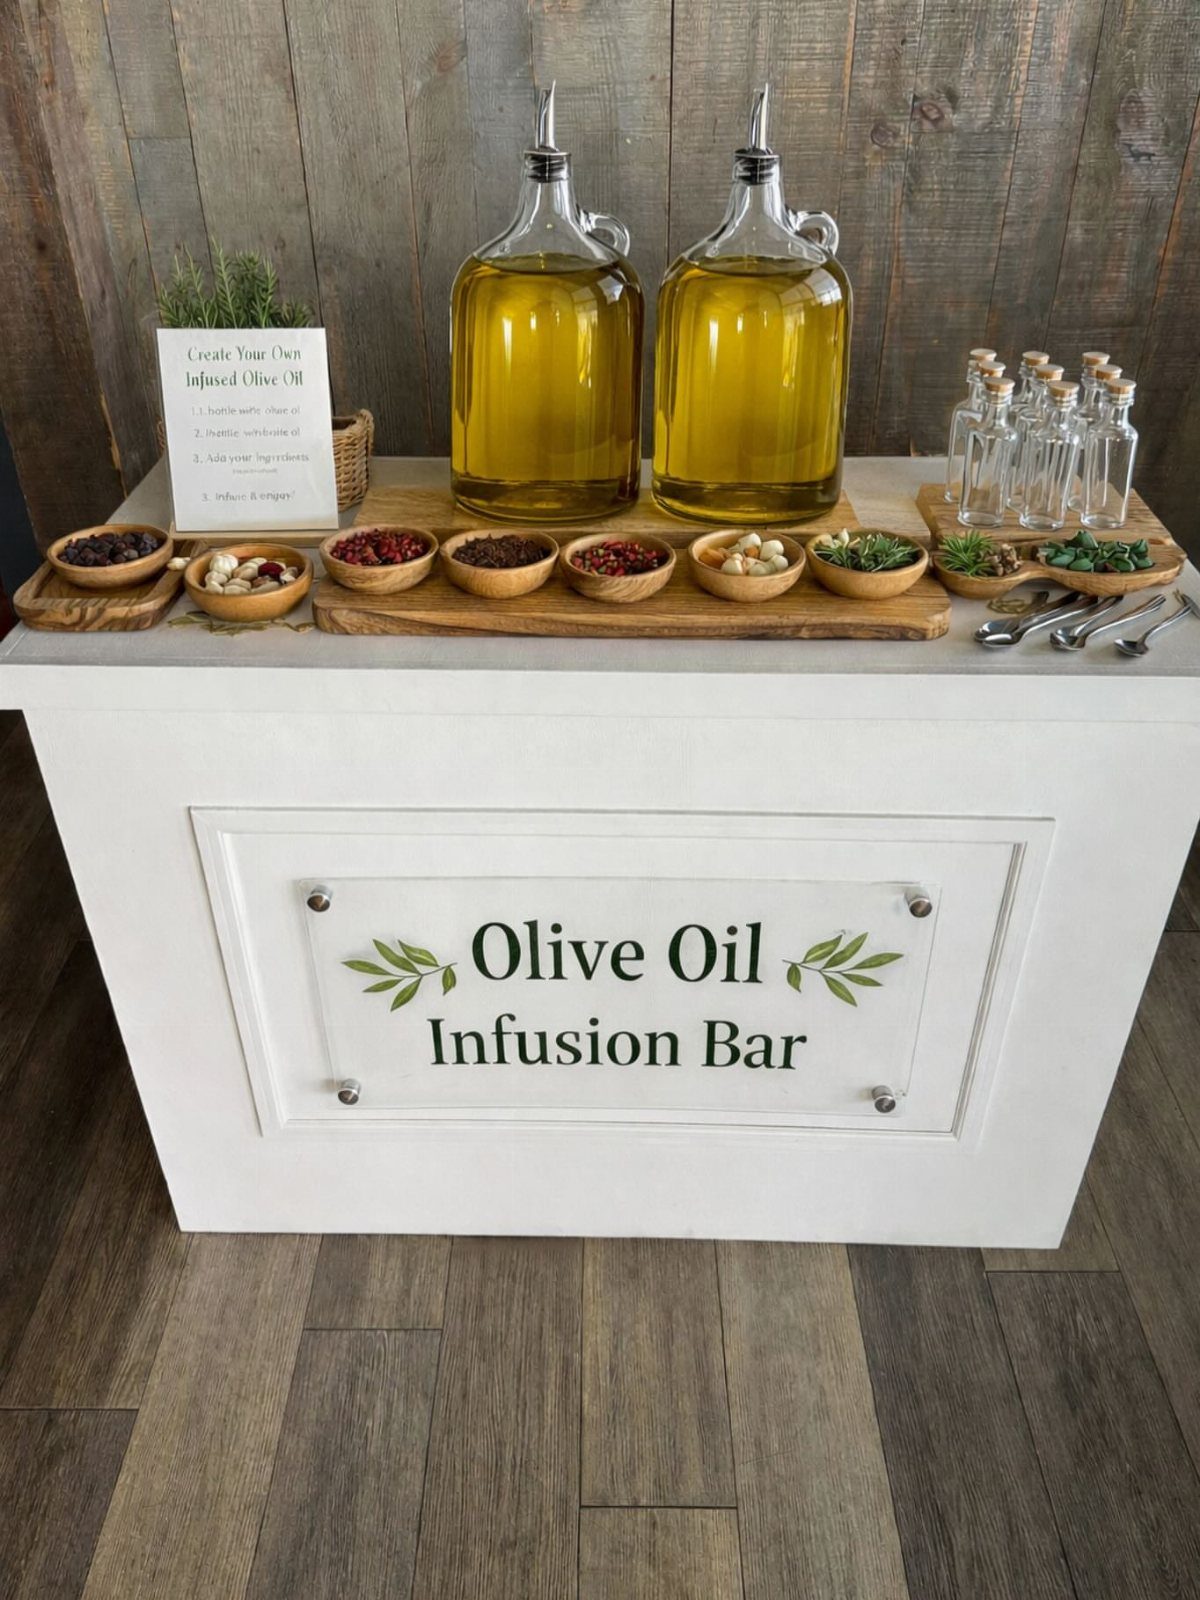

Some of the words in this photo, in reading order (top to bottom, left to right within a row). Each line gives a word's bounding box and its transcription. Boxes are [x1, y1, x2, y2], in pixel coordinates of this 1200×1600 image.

[187, 346, 232, 361] Create
[235, 345, 267, 361] Your
[271, 344, 302, 360] Own
[186, 370, 237, 390] Infused
[242, 369, 278, 387] Olive
[283, 369, 303, 386] Oil
[471, 919, 645, 982] Olive
[668, 921, 763, 984] Oil
[428, 1013, 680, 1066] Infusion
[702, 1020, 808, 1070] Bar
